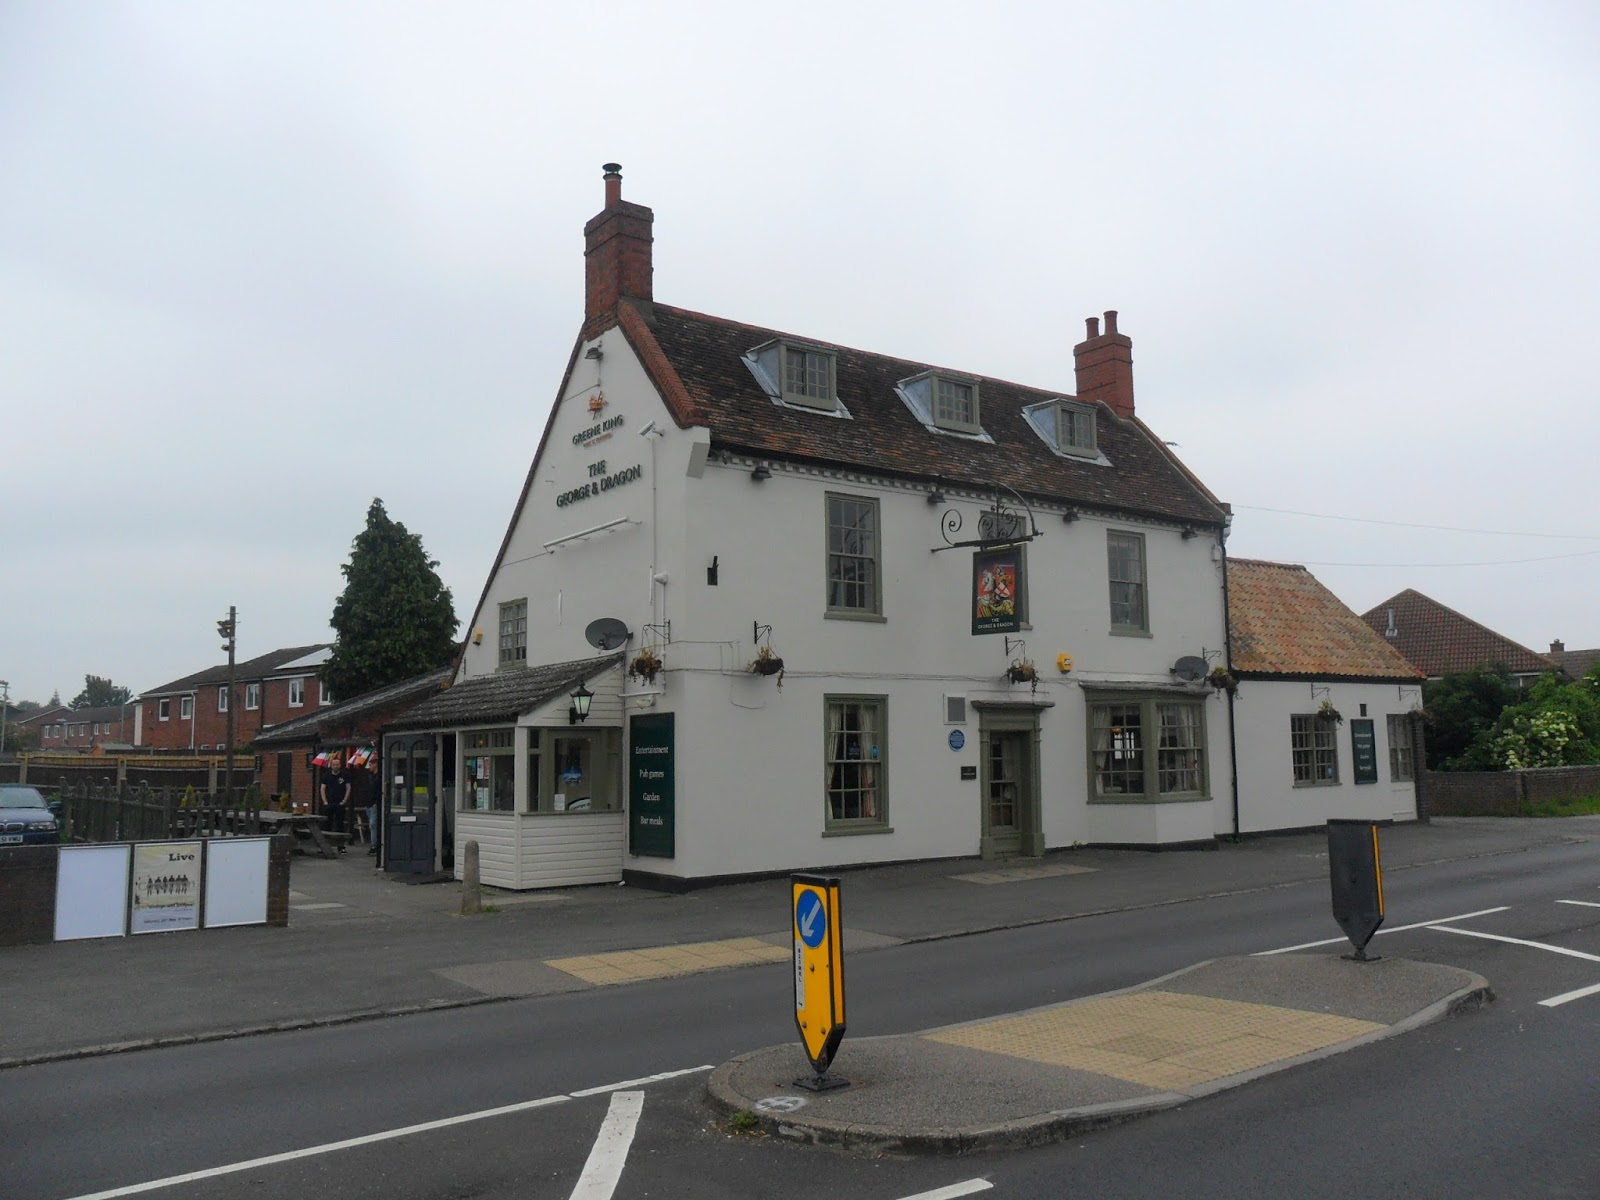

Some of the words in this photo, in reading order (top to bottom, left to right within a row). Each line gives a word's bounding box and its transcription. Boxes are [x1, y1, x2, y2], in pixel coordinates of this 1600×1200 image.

[572, 424, 601, 445] GREENE
[602, 414, 624, 432] KING
[587, 460, 607, 478] THE
[556, 483, 591, 508] GEORGE
[591, 481, 599, 496] &
[600, 464, 642, 492] DRAGON
[635, 745, 669, 755] Entertainment
[642, 792, 661, 801] Garden
[169, 853, 195, 862] Live
